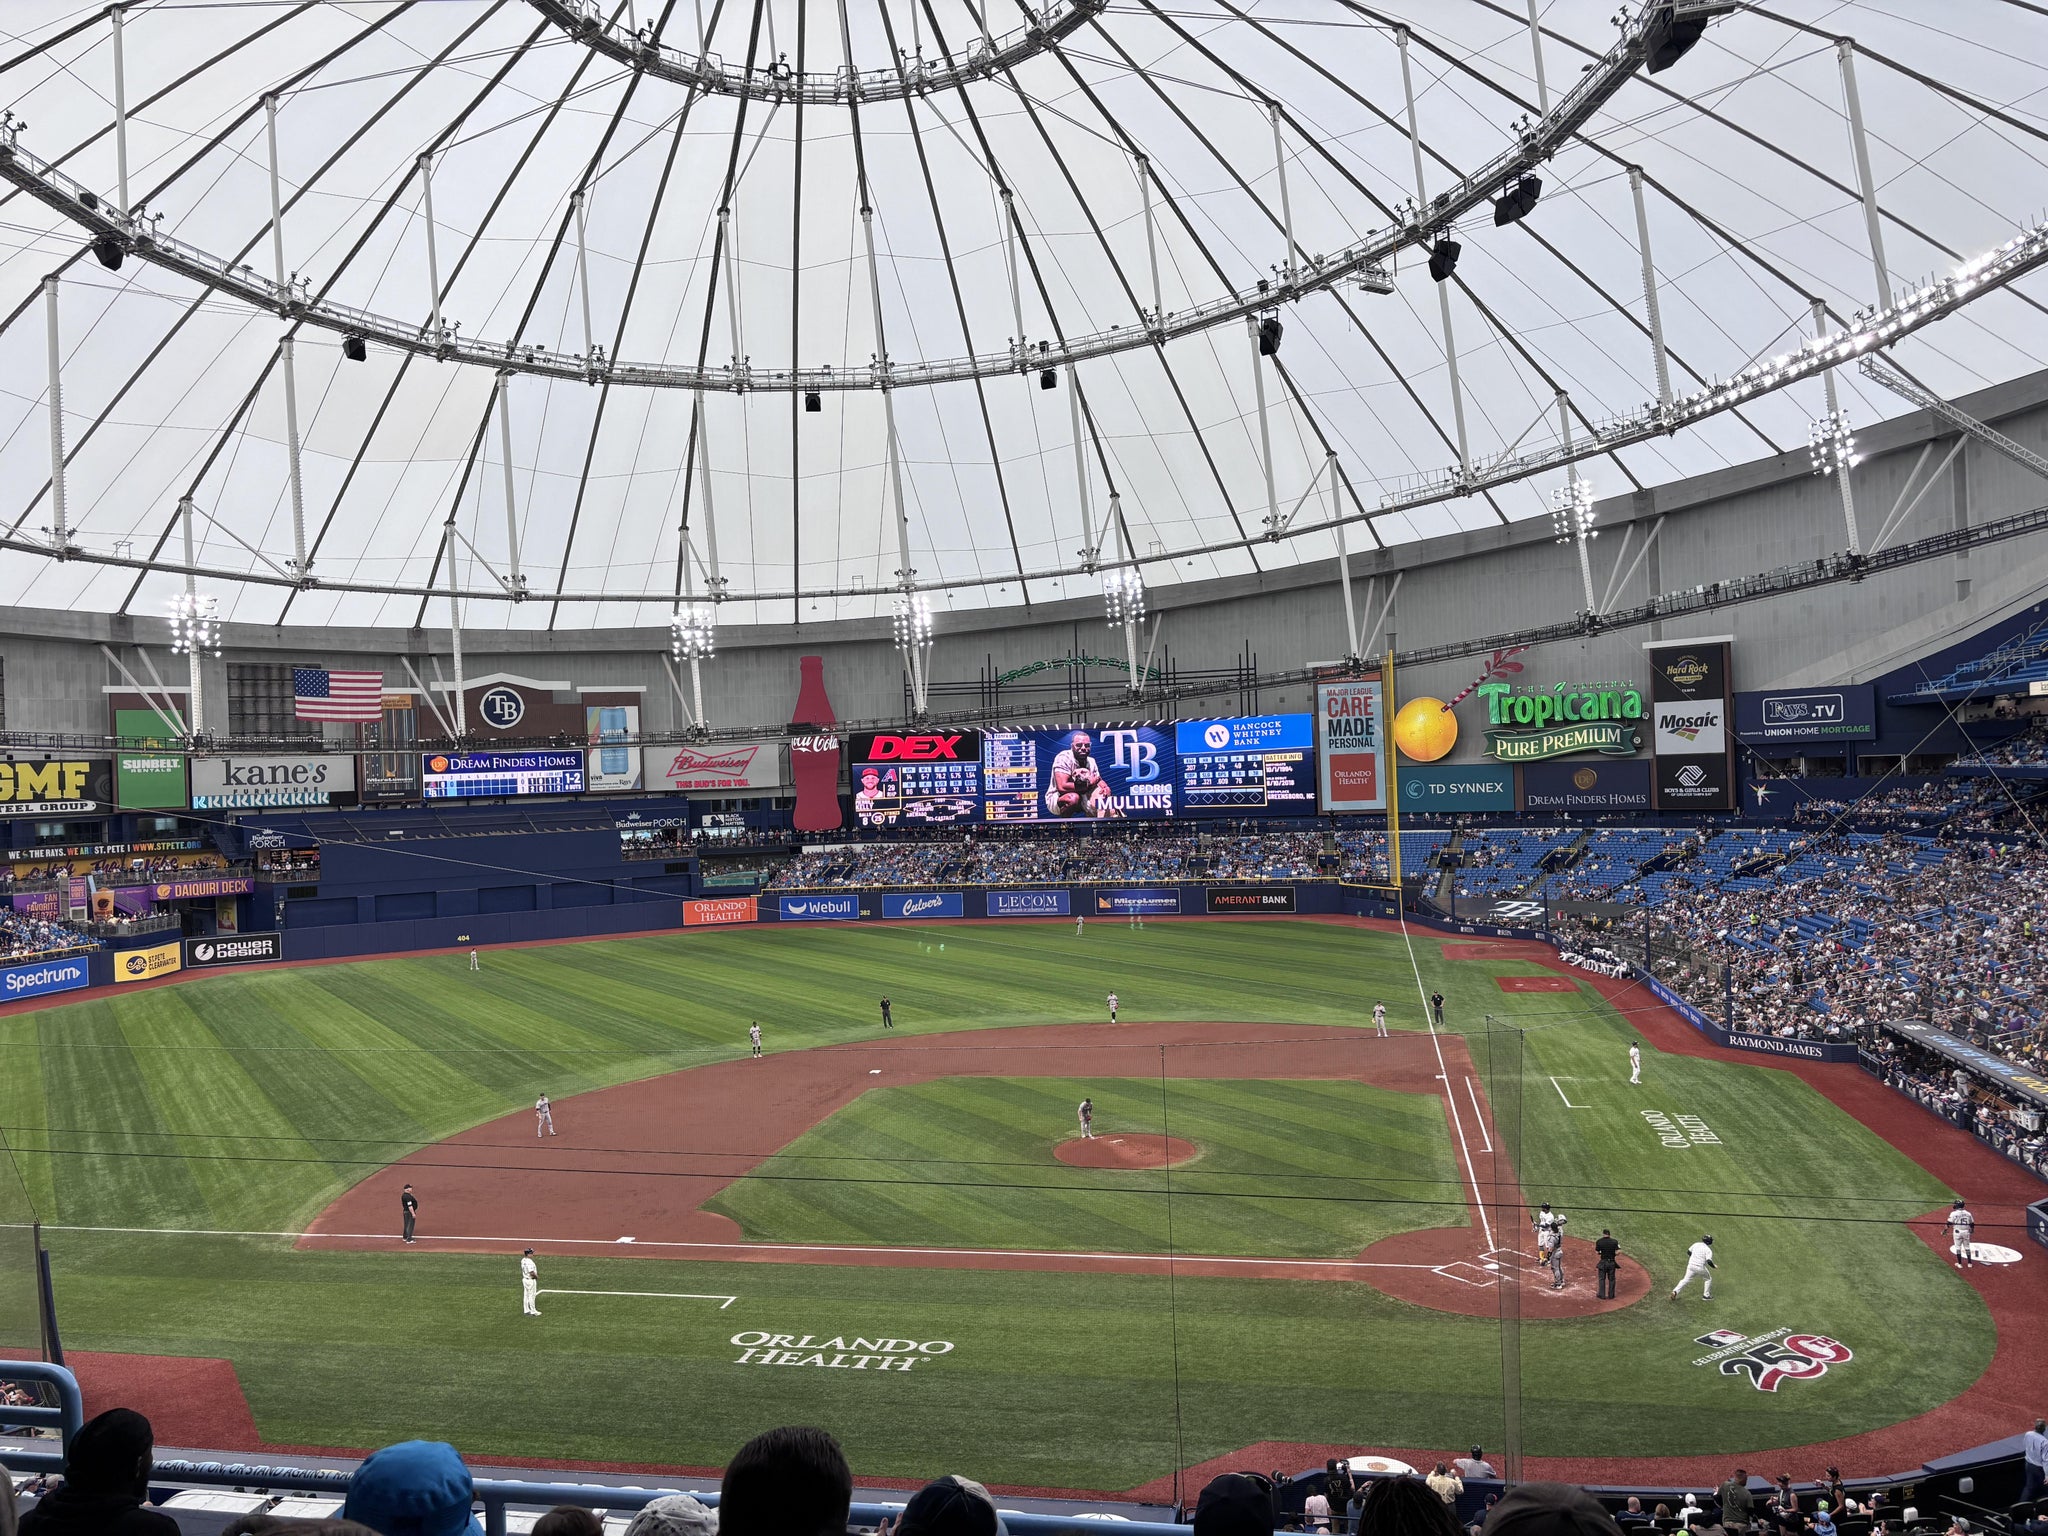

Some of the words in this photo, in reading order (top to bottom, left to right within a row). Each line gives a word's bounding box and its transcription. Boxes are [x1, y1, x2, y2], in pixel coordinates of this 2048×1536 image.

[1666, 664, 1687, 675] Hard
[1688, 663, 1708, 675] Rock
[1572, 679, 1635, 690] ORIGINAL
[1326, 688, 1349, 697] MAJOR
[1349, 687, 1373, 696] LEAGUE
[488, 695, 518, 721] TB
[1327, 696, 1374, 718] CARE
[1477, 681, 1642, 728] Tropicana
[1233, 720, 1282, 731] HANCOCK
[1659, 711, 1719, 729] Mosaic
[1233, 728, 1282, 738] WHITNEY
[1328, 717, 1375, 737] MADE
[1764, 728, 1793, 737] UNION
[1793, 727, 1820, 736] HOME
[1820, 724, 1871, 734] MORTGAGE
[867, 735, 963, 760] DEX
[1234, 738, 1260, 746] BANK
[1328, 737, 1375, 749] PERSONAL
[674, 753, 751, 771] Budweiser
[1099, 729, 1160, 783] TB
[221, 759, 328, 786] kane's
[564, 772, 581, 784] 1-2
[1334, 770, 1372, 778] ORLANDO
[675, 780, 692, 788] THIS
[694, 780, 716, 788] BUD'S
[734, 778, 750, 787] YOU.
[1338, 777, 1368, 785] HEALTH
[233, 786, 319, 795] FURNITURE
[1131, 783, 1173, 794] CEDRIC
[1428, 784, 1446, 795] TD
[1449, 782, 1504, 794] SYNNEX
[1098, 794, 1172, 810] MULLINS
[1306, 792, 1316, 800] NC
[40, 802, 89, 812] GROUP
[615, 821, 652, 829] Budweiser
[652, 818, 688, 828] PORCH
[862, 818, 868, 826] 8
[888, 816, 897, 824] 17
[250, 839, 286, 849] PORCH
[251, 834, 284, 842] Budweiser
[8, 850, 21, 860] WE
[29, 850, 45, 859] THE
[45, 848, 66, 858] RAYS.
[67, 847, 79, 856] WE
[106, 844, 126, 854] PETE
[174, 882, 219, 898] DAIQUIRI
[221, 879, 248, 894] DECK
[44, 893, 58, 902] FAN
[1214, 895, 1261, 905] AMERANT
[1262, 895, 1288, 904] BANK
[26, 902, 58, 913] FAVORITE
[694, 902, 747, 913] ORLANDO
[809, 900, 851, 913] Webull
[902, 894, 944, 916] Culver's
[701, 910, 742, 922] HEALTH
[457, 934, 470, 942] 404
[148, 956, 176, 970] CLEARWATER
[6, 967, 78, 993] Spectrum
[1729, 1034, 1784, 1052] RAYMOND
[1784, 1042, 1823, 1058] JAMES
[730, 1331, 955, 1354] ORLANDO
[1691, 1340, 1750, 1366] CELEBRATING
[1746, 1326, 1793, 1348] AMERICA'S
[733, 1348, 919, 1372] HEALTH
